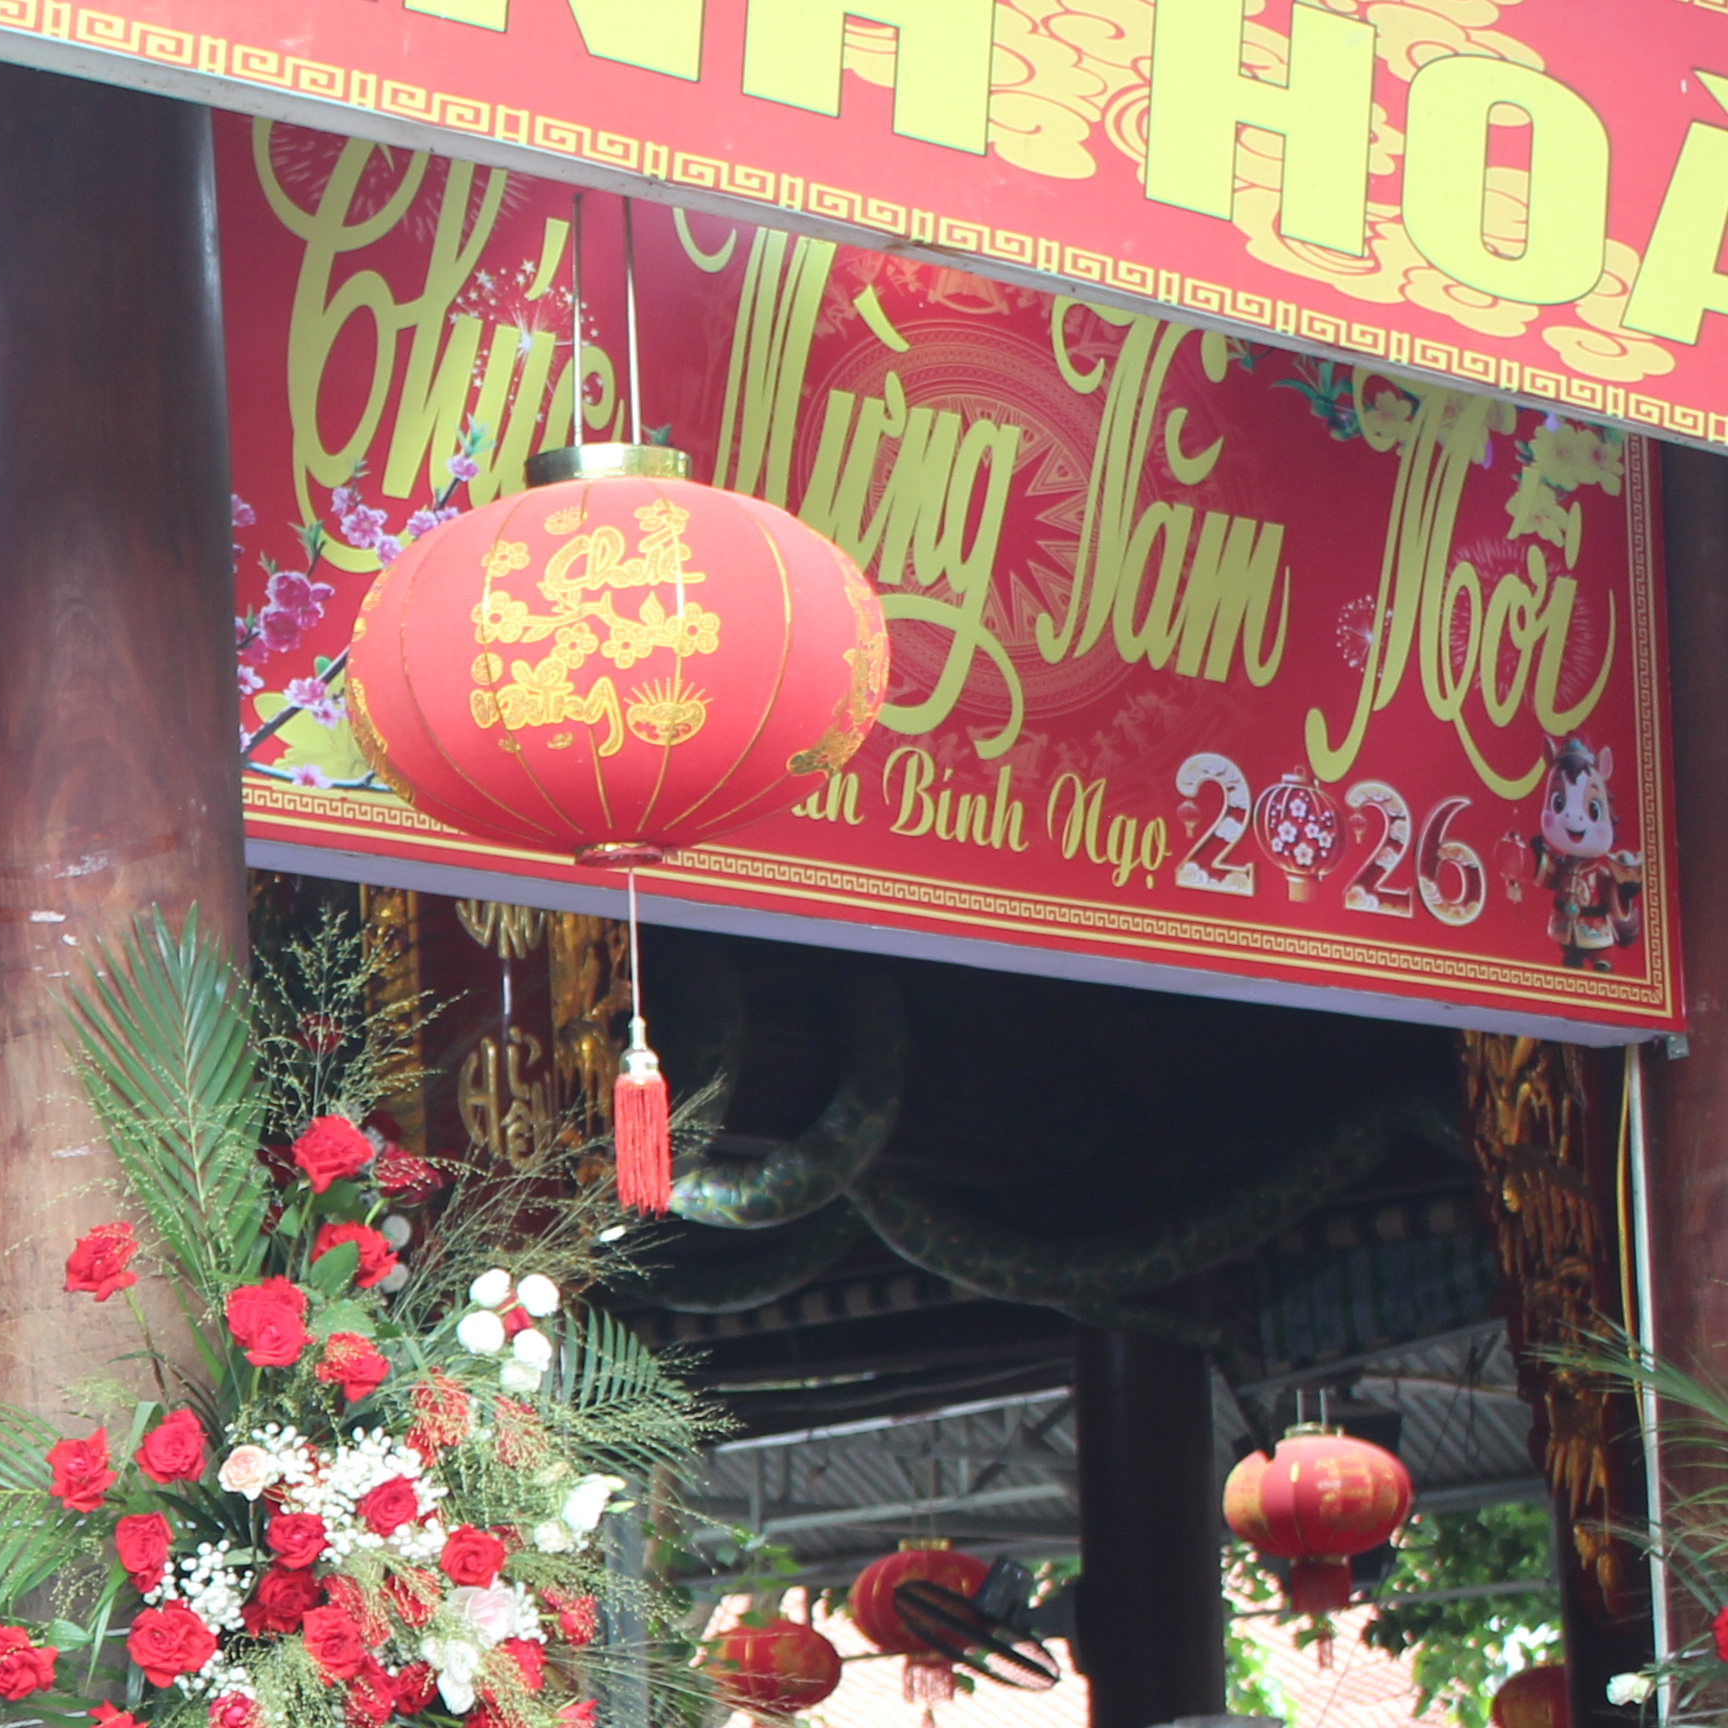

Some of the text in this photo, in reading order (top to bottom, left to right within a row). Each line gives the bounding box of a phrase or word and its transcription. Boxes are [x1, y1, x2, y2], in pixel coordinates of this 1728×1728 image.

[252, 118, 1616, 799] Chúc Mừng Năm Mới
[883, 746, 1030, 853] Bính
[1045, 771, 1172, 889] Ngọ
[1175, 752, 1487, 926] 2026
